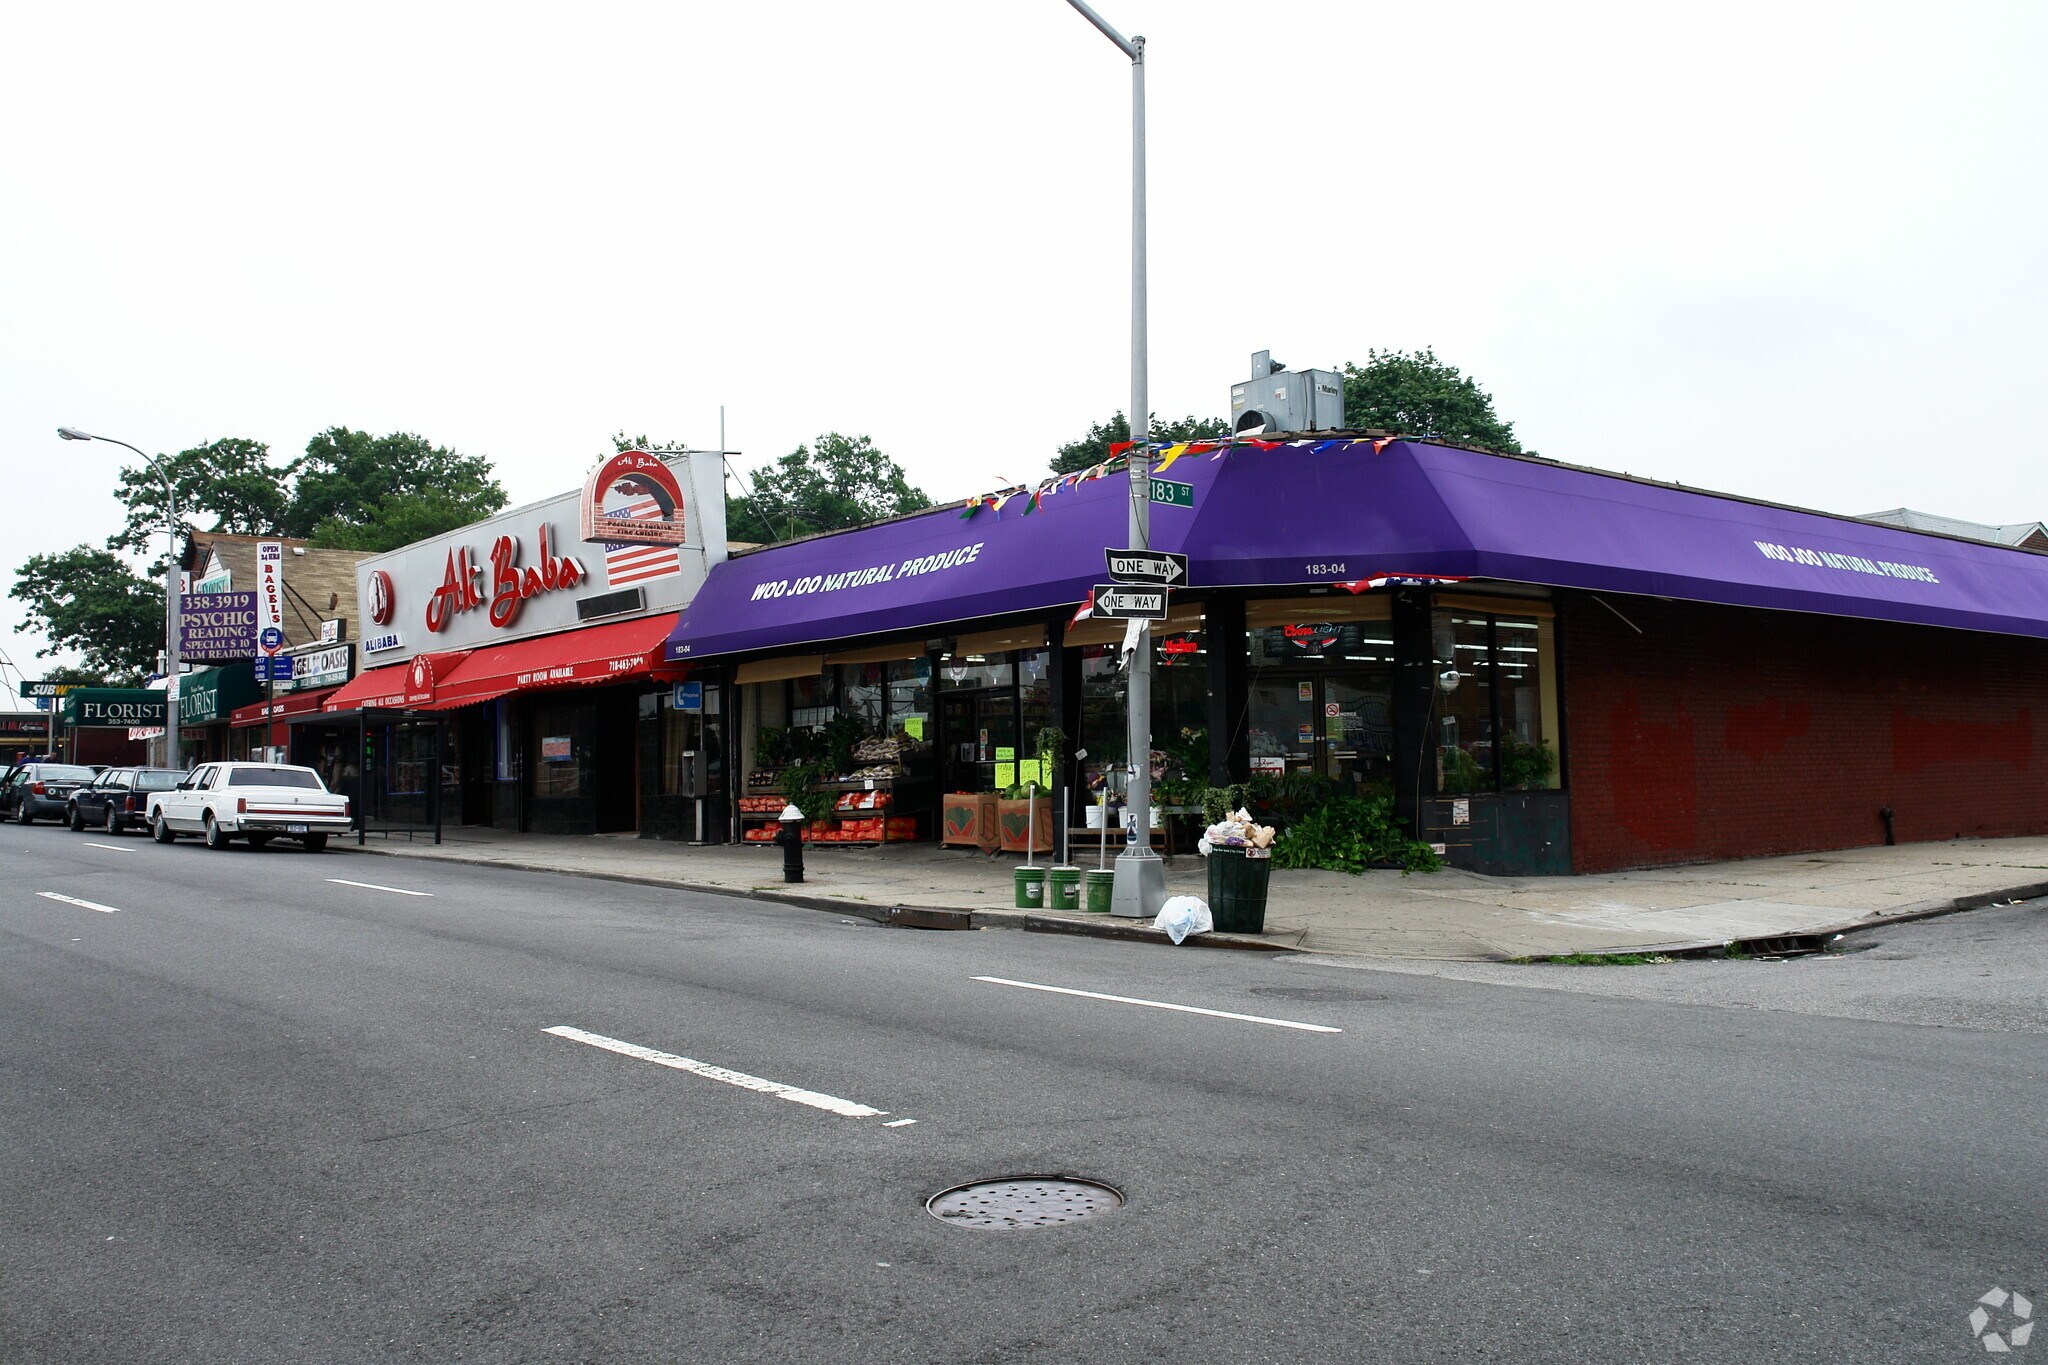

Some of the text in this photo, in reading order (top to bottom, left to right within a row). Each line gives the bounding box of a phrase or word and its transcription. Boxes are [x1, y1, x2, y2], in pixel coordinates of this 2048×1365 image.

[617, 456, 658, 468] Ali Baba
[1152, 481, 1190, 501] 183 ST
[1117, 560, 1176, 576] ONE WAY
[1306, 563, 1346, 575] 183-04
[1754, 541, 1940, 584] WOO JOO NATURAL PRODUCE
[426, 522, 585, 632] Ali Baba
[751, 542, 984, 601] WOO JOO NATURAL PRODUCE
[264, 565, 281, 623] BAGELS
[184, 595, 249, 610] 358-3919
[1104, 596, 1157, 609] ONE WAY
[181, 611, 255, 628] PSYCHIC
[188, 627, 247, 639] READING
[323, 624, 336, 637] FedEx
[1284, 624, 1343, 637] Coors LIGHT
[185, 640, 228, 650] SPECIAL
[240, 639, 249, 648] 10
[365, 634, 398, 652] ALIBABA
[675, 645, 691, 654] 183-04
[180, 650, 206, 660] PALM
[208, 648, 256, 659] READING
[321, 649, 348, 671] OASIS
[518, 667, 574, 684] PARTY ROOM AVAILABLE
[83, 703, 164, 718] FLORIST
[180, 689, 217, 718] FLORIST
